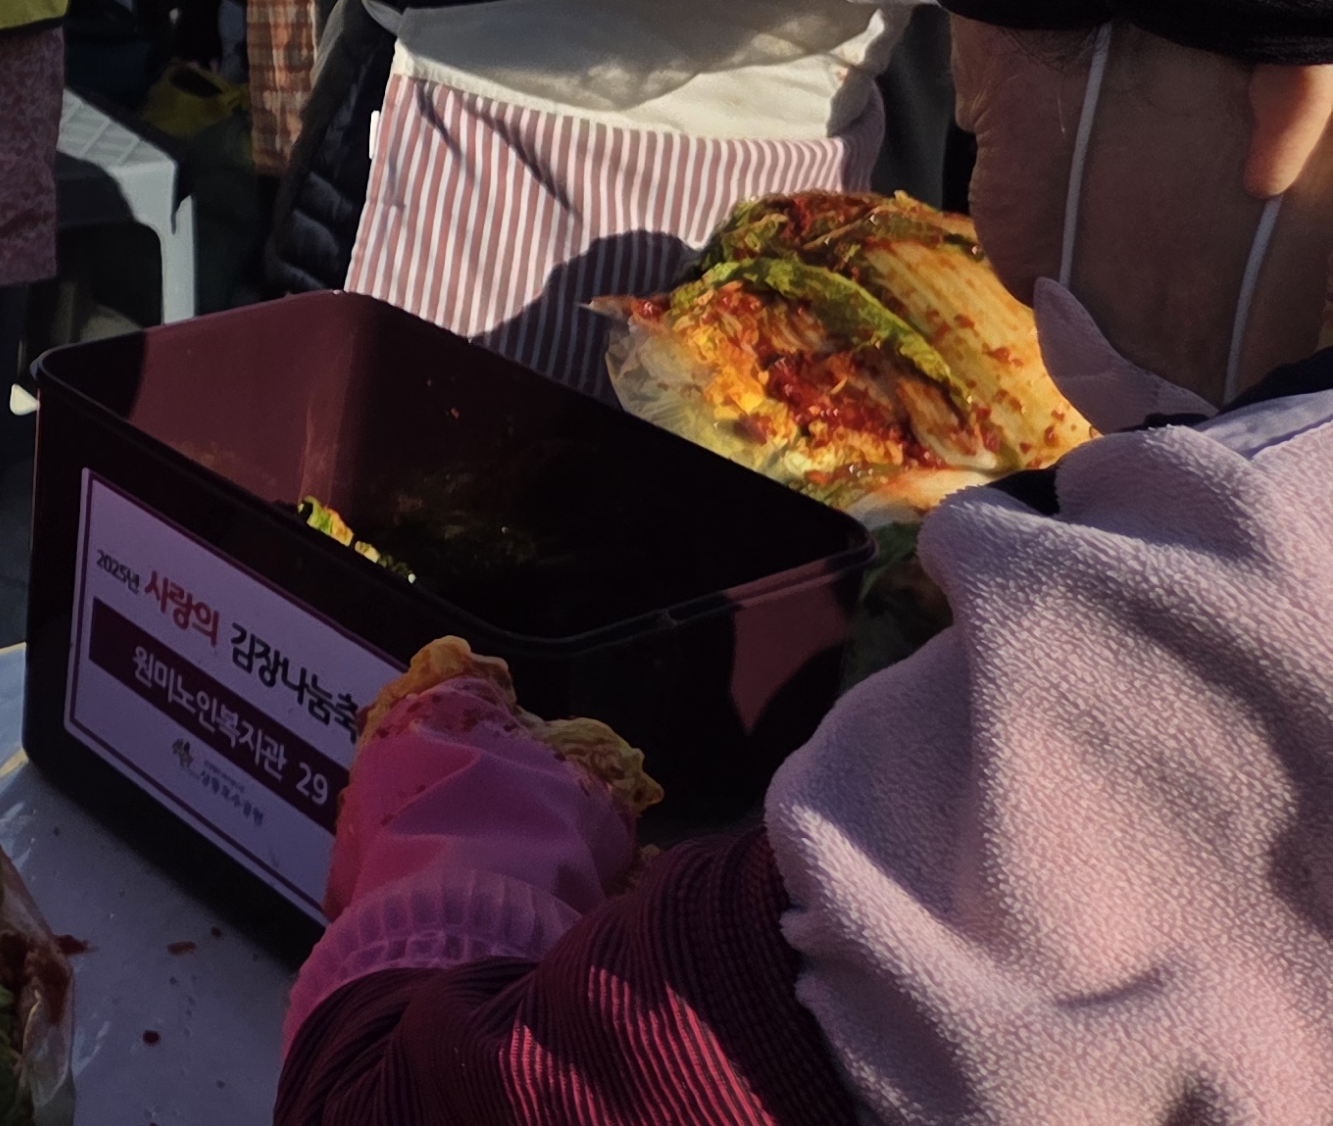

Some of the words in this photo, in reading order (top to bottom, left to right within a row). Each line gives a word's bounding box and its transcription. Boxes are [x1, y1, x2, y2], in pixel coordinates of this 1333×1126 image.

[96, 549, 141, 595] 2025년
[144, 570, 220, 648] 사랑의
[133, 645, 287, 782] 원미노인복지관
[295, 761, 329, 805] 29
